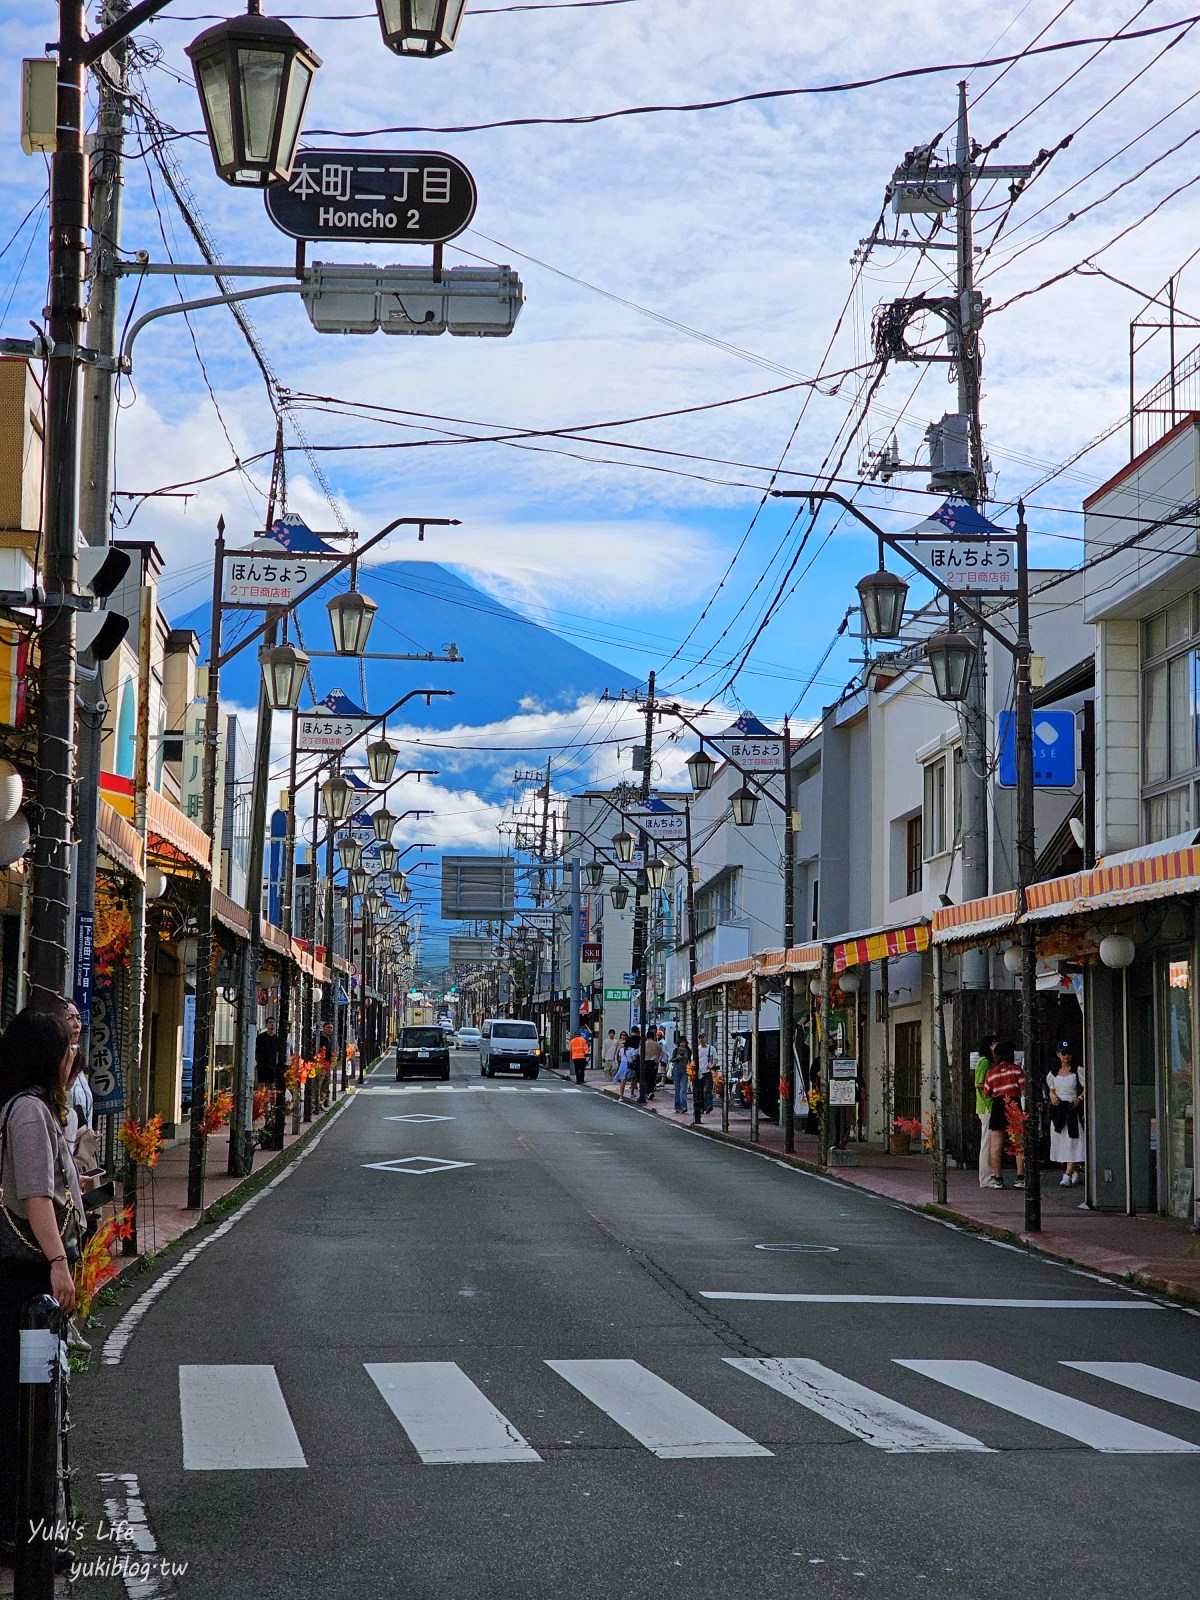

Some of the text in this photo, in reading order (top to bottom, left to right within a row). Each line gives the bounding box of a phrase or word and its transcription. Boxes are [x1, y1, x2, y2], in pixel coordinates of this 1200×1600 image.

[288, 163, 451, 203] 本町二丁目
[319, 207, 420, 229] Honcho 2
[931, 548, 1010, 567] ほんちょう
[232, 563, 308, 583] ほんちょう
[947, 571, 1010, 583] 2丁目商店街
[230, 586, 291, 598] 2丁目商店街
[302, 722, 353, 735] ほんちょう
[731, 744, 780, 756] ほんちょう
[646, 818, 683, 828] ほんちょう
